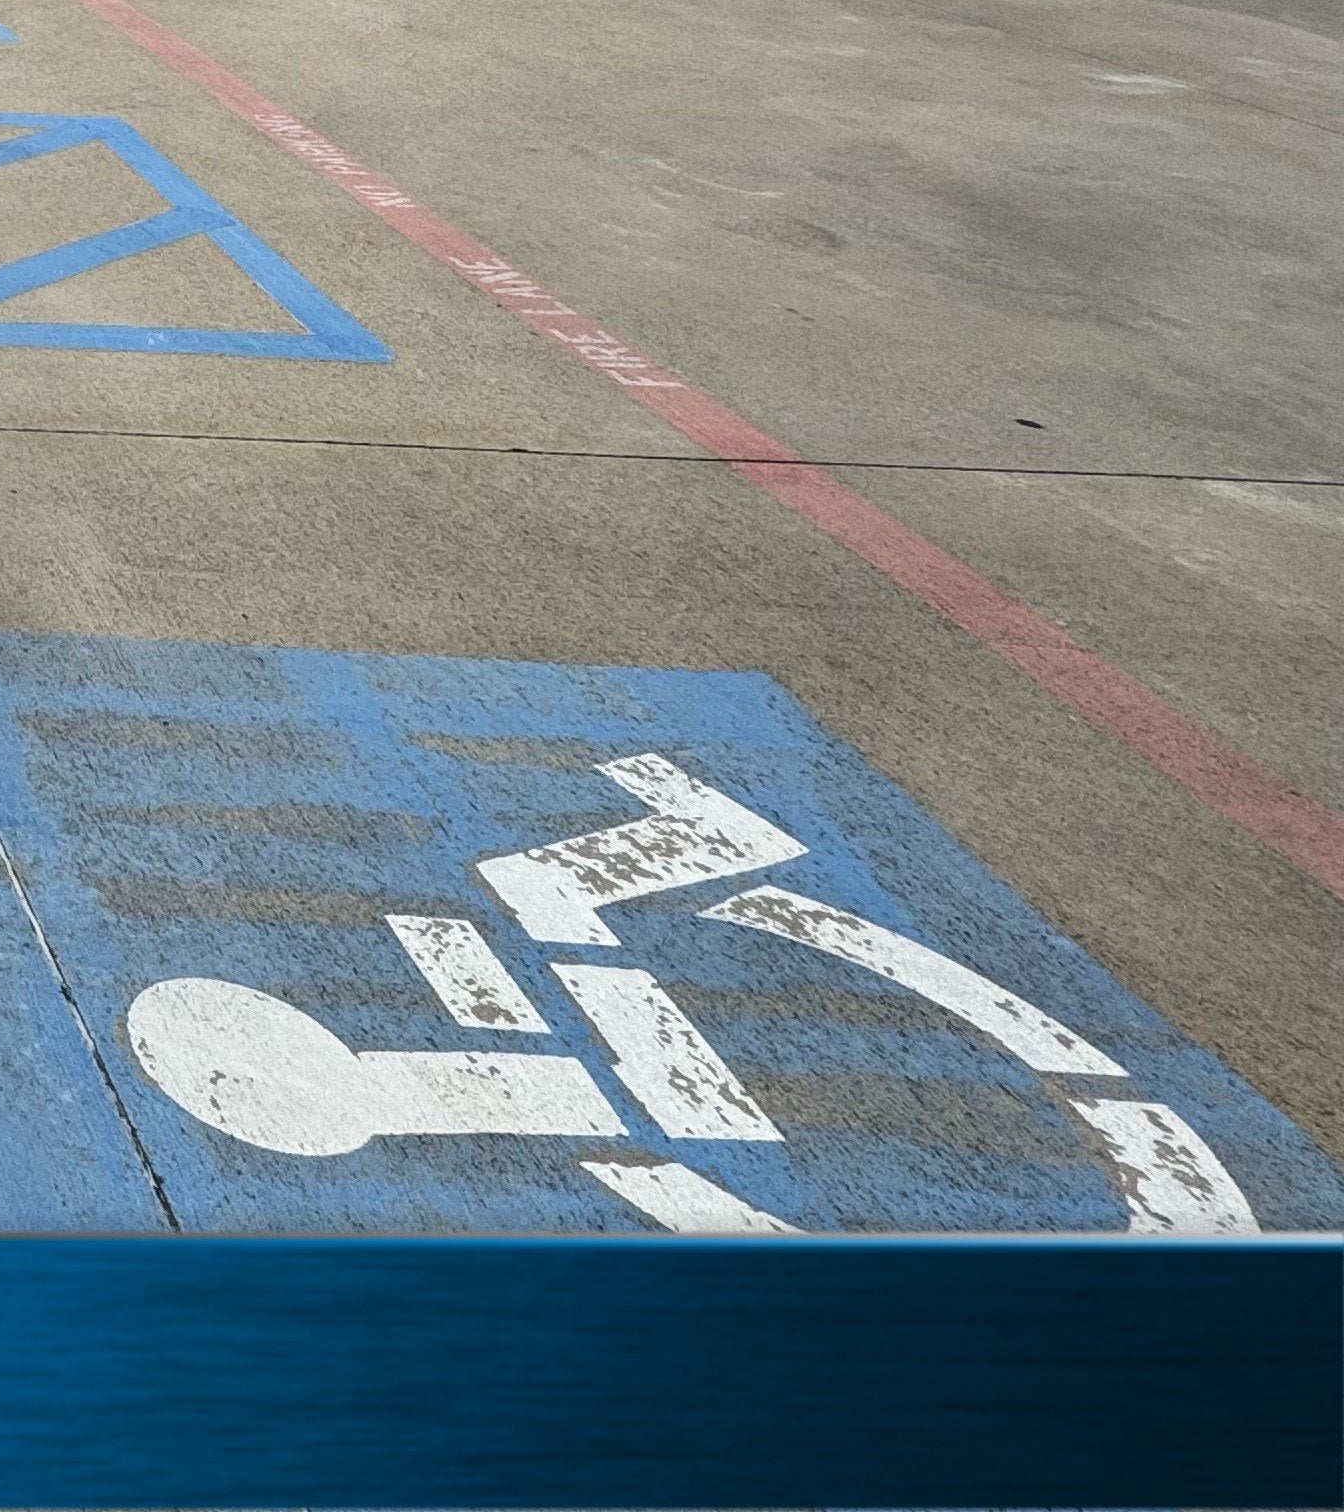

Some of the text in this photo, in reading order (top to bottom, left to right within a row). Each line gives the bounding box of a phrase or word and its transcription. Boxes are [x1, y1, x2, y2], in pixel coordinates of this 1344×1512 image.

[352, 184, 417, 208] NO
[447, 255, 578, 315] LANE
[548, 328, 688, 388] FIRE
